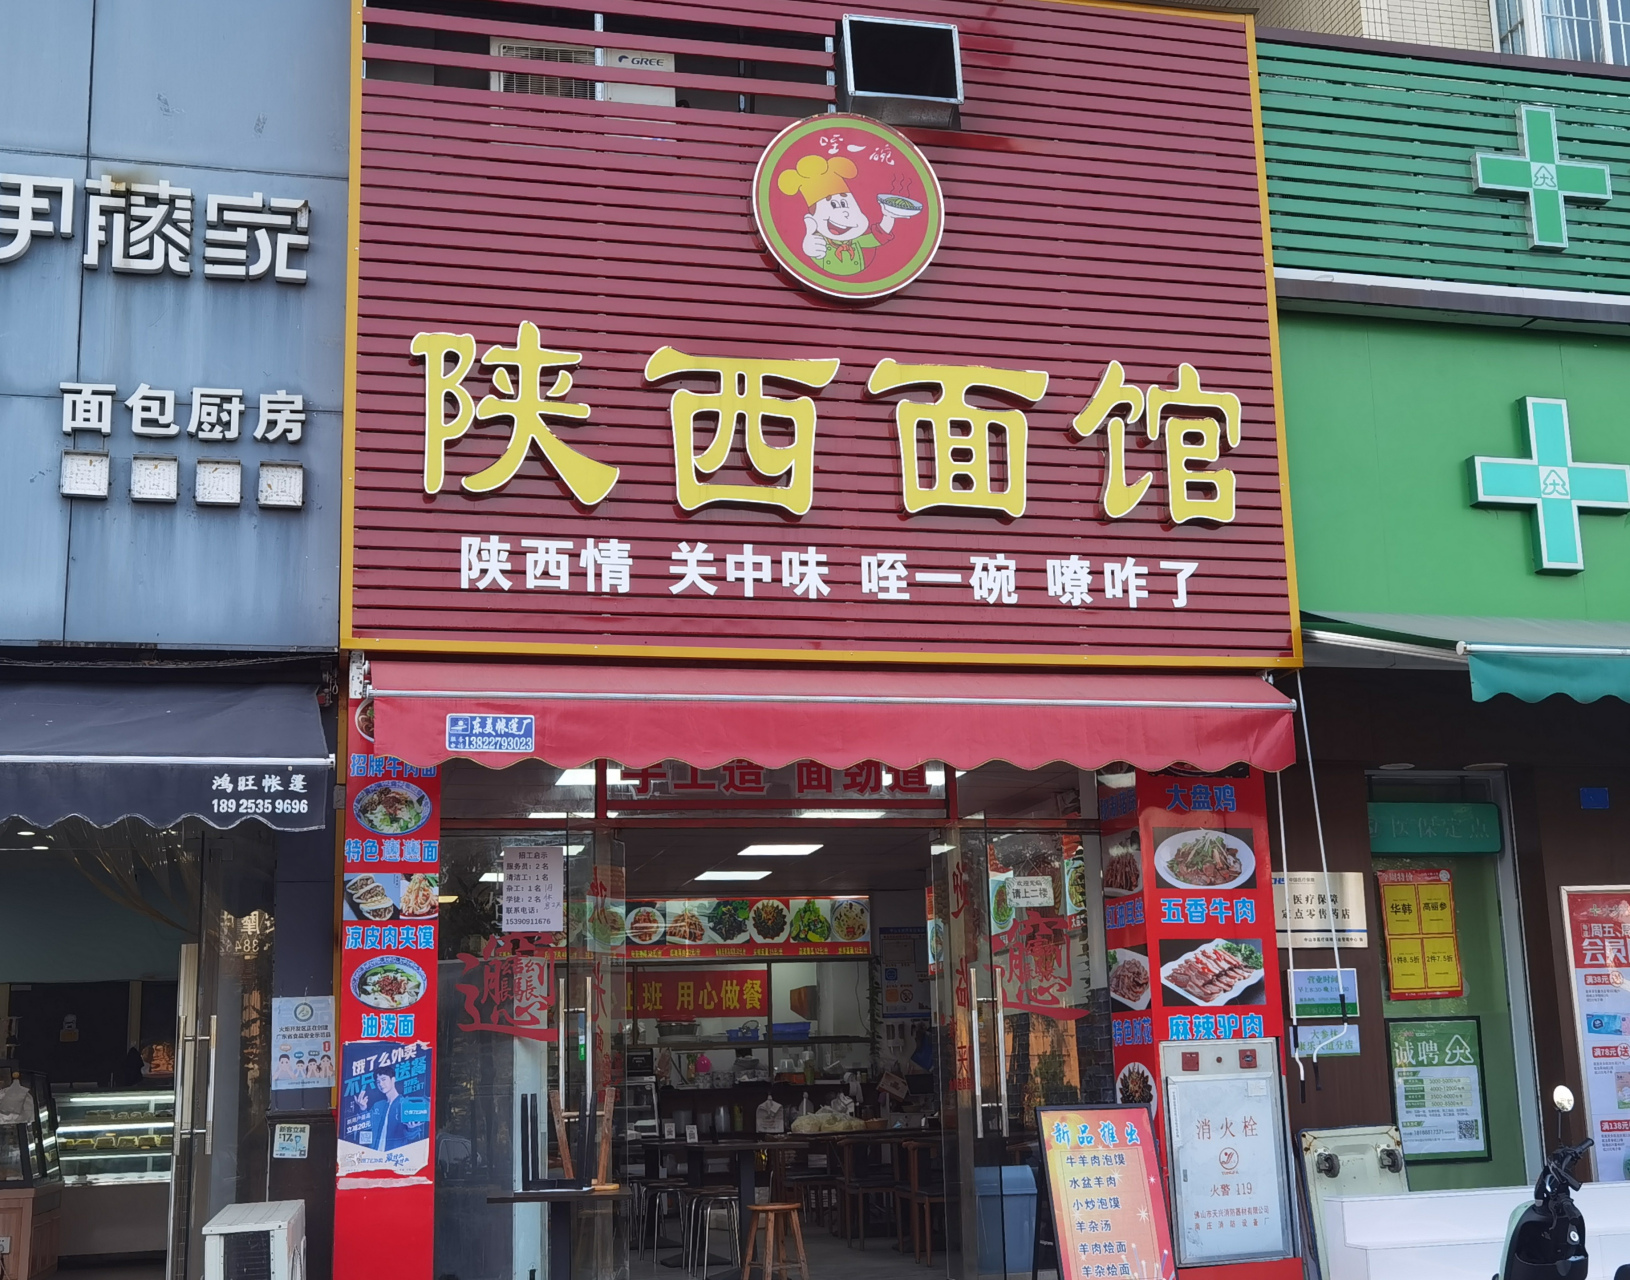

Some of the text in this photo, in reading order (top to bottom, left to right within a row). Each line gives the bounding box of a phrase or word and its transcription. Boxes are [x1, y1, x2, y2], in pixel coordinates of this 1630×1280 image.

[630, 57, 665, 67] GREE
[59, 382, 307, 444] 面包厨房
[410, 320, 1242, 525] 陕西面馆
[460, 535, 1199, 608] 陕西情 关中味 咥一碗 嘹咋了
[464, 736, 532, 750] 13822793023
[212, 799, 308, 813] 189 2535 9696
[1166, 784, 1237, 813] 大盘鸡
[1012, 887, 1048, 899] 请上二楼
[1293, 893, 1338, 906] 医疗保障
[1160, 898, 1255, 924] 五香牛肉
[346, 926, 435, 950] 凉皮肉夹馍
[1582, 938, 1630, 966] 会员
[676, 979, 763, 1011] 用心做餐
[361, 1013, 415, 1038] 油泼面
[1168, 1013, 1264, 1039] 麻辣驴肉
[352, 1044, 418, 1076] 饿了么外卖
[1393, 1040, 1440, 1066] 诚聘
[344, 1072, 376, 1097] 不只
[394, 1055, 427, 1082] 送餐
[1051, 1121, 1142, 1148] 新品推出
[1196, 1116, 1259, 1141] 消火栓
[1066, 1154, 1126, 1168] 牛羊肉泡馍
[1069, 1176, 1117, 1190] 水盆羊肉
[1210, 1181, 1253, 1197] 火警 119
[1072, 1197, 1121, 1211] 小炒泡馍
[1076, 1219, 1112, 1233] 羊杂汤
[1078, 1241, 1128, 1256] 羊肉烩面
[1081, 1263, 1131, 1278] 羊杂烩面
